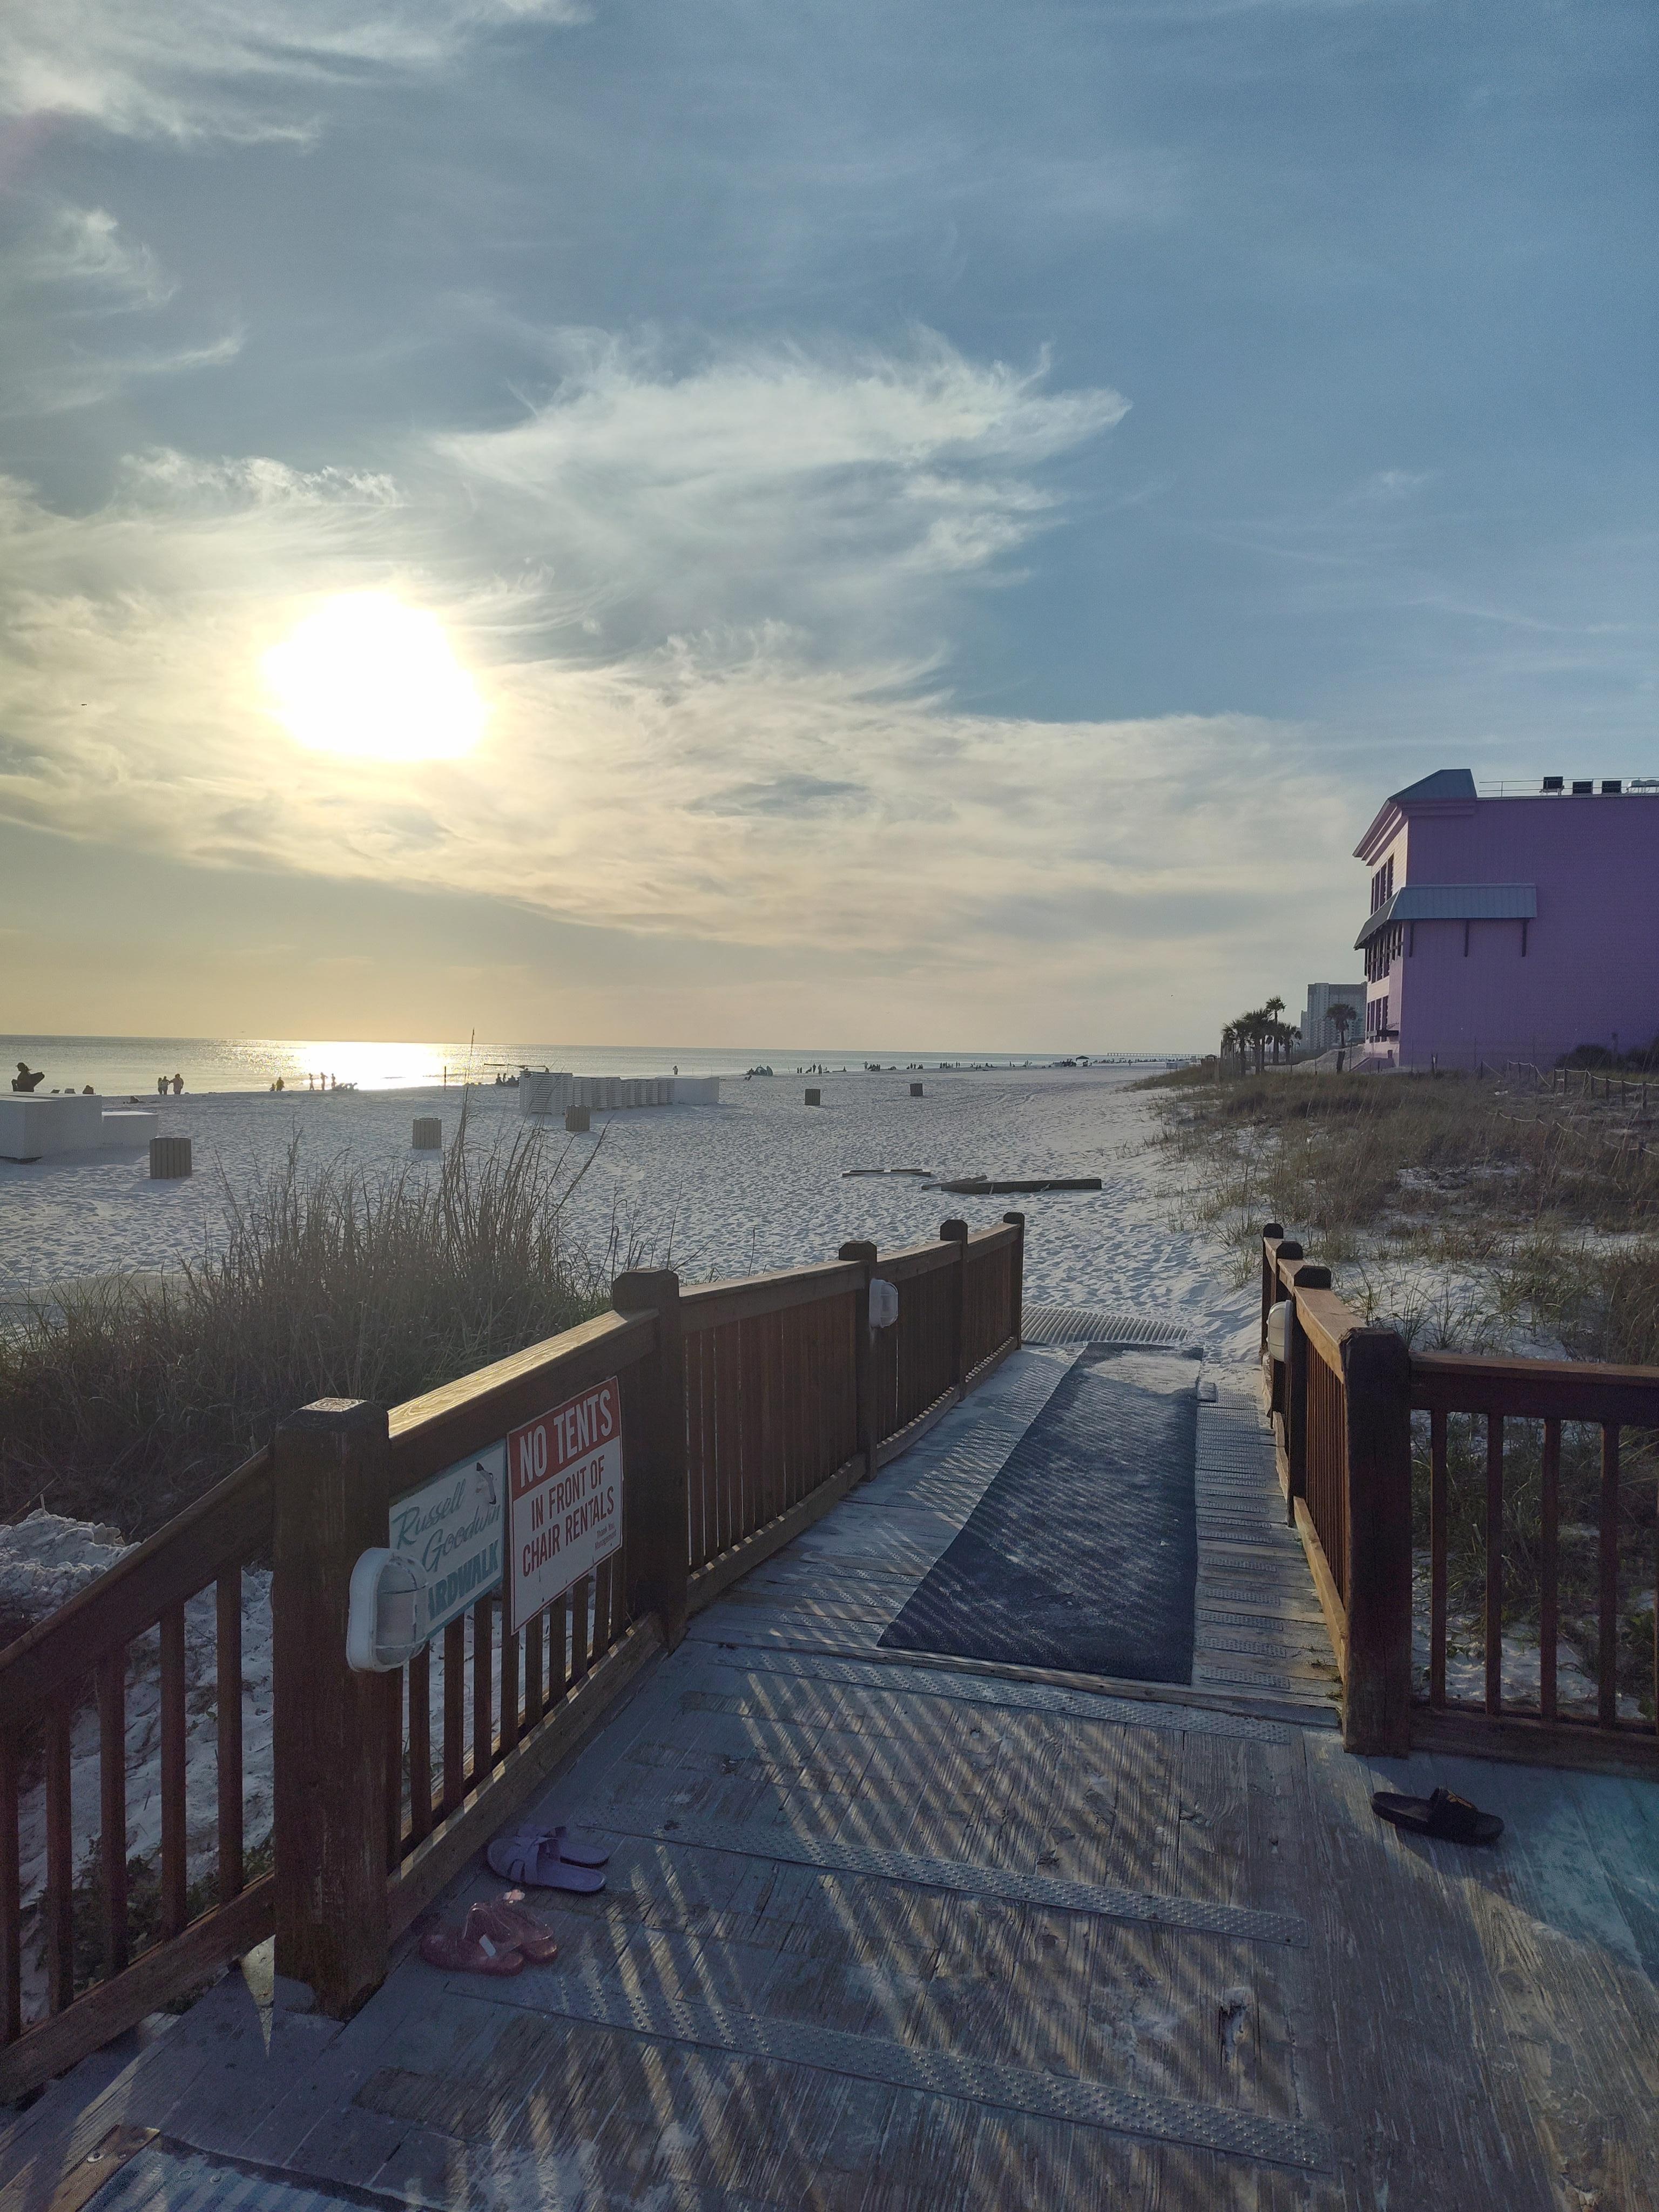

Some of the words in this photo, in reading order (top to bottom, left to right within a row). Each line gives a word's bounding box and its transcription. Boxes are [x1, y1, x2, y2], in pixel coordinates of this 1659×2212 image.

[520, 1425, 547, 1488] NO
[554, 1389, 612, 1464] TENTS
[392, 1478, 466, 1549] Russell
[531, 1494, 543, 1532] IN
[549, 1466, 586, 1519] FRONT
[590, 1455, 604, 1489] OF
[422, 1505, 501, 1572] Goodwin
[523, 1523, 560, 1577] CHAIR
[565, 1486, 614, 1546] RENTALS
[597, 1526, 607, 1539] Thank
